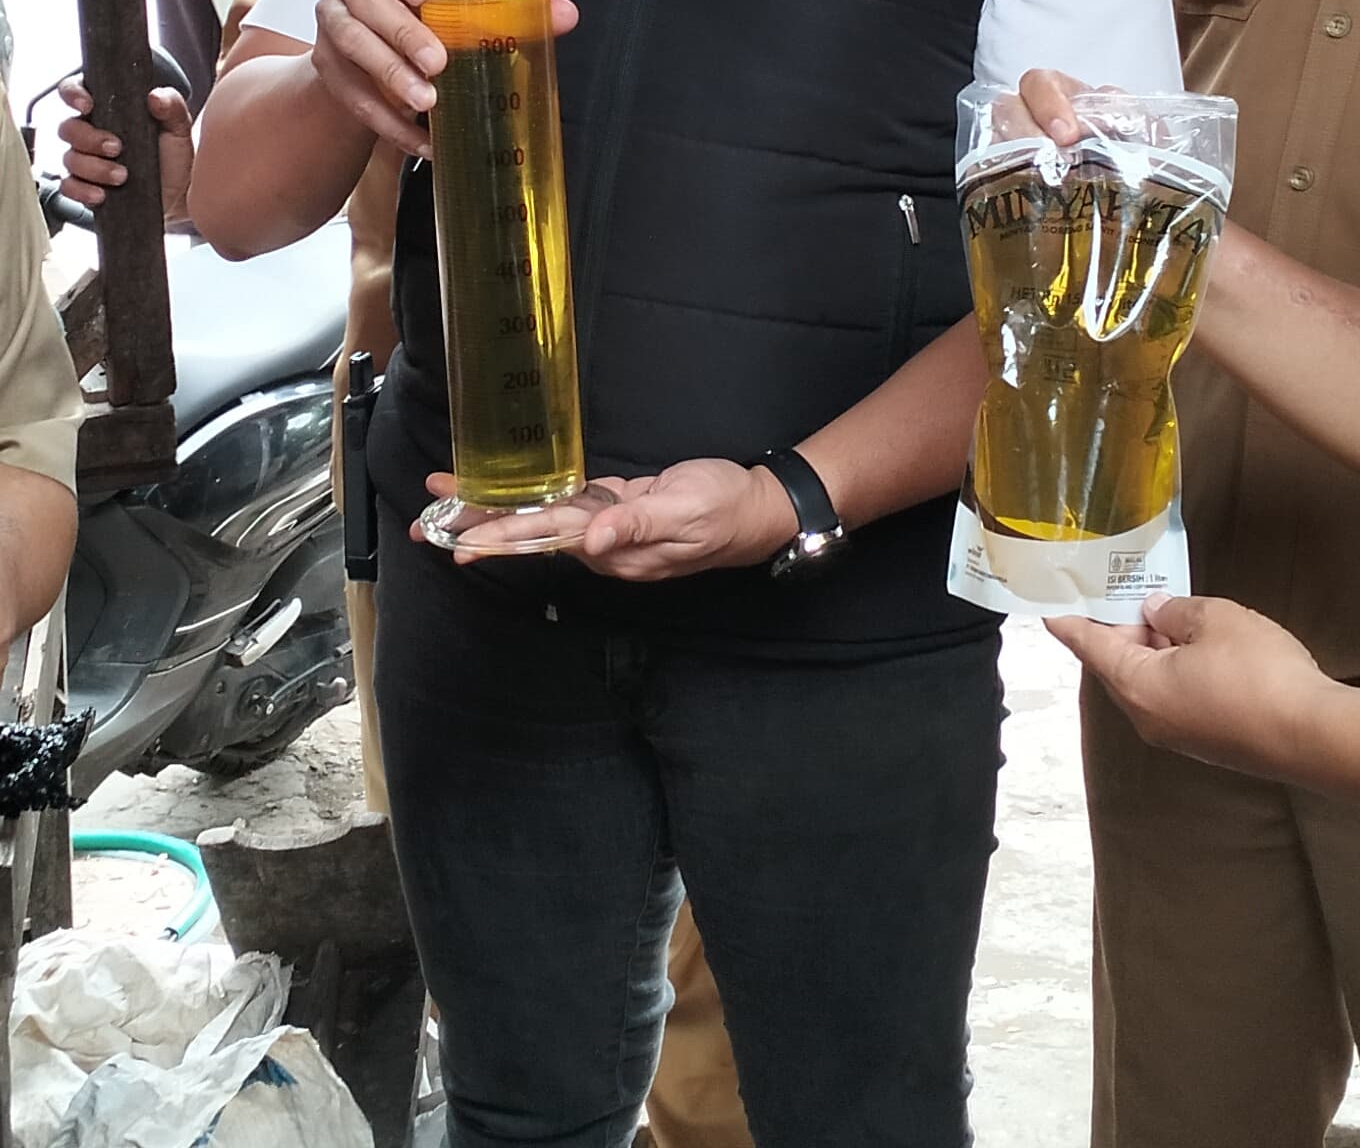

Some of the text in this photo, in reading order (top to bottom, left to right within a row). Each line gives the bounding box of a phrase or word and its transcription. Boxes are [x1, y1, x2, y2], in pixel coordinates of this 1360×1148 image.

[499, 314, 537, 334] 300
[503, 370, 541, 390] 200
[509, 424, 545, 444] 100
[1117, 574, 1145, 584] BERSIH
